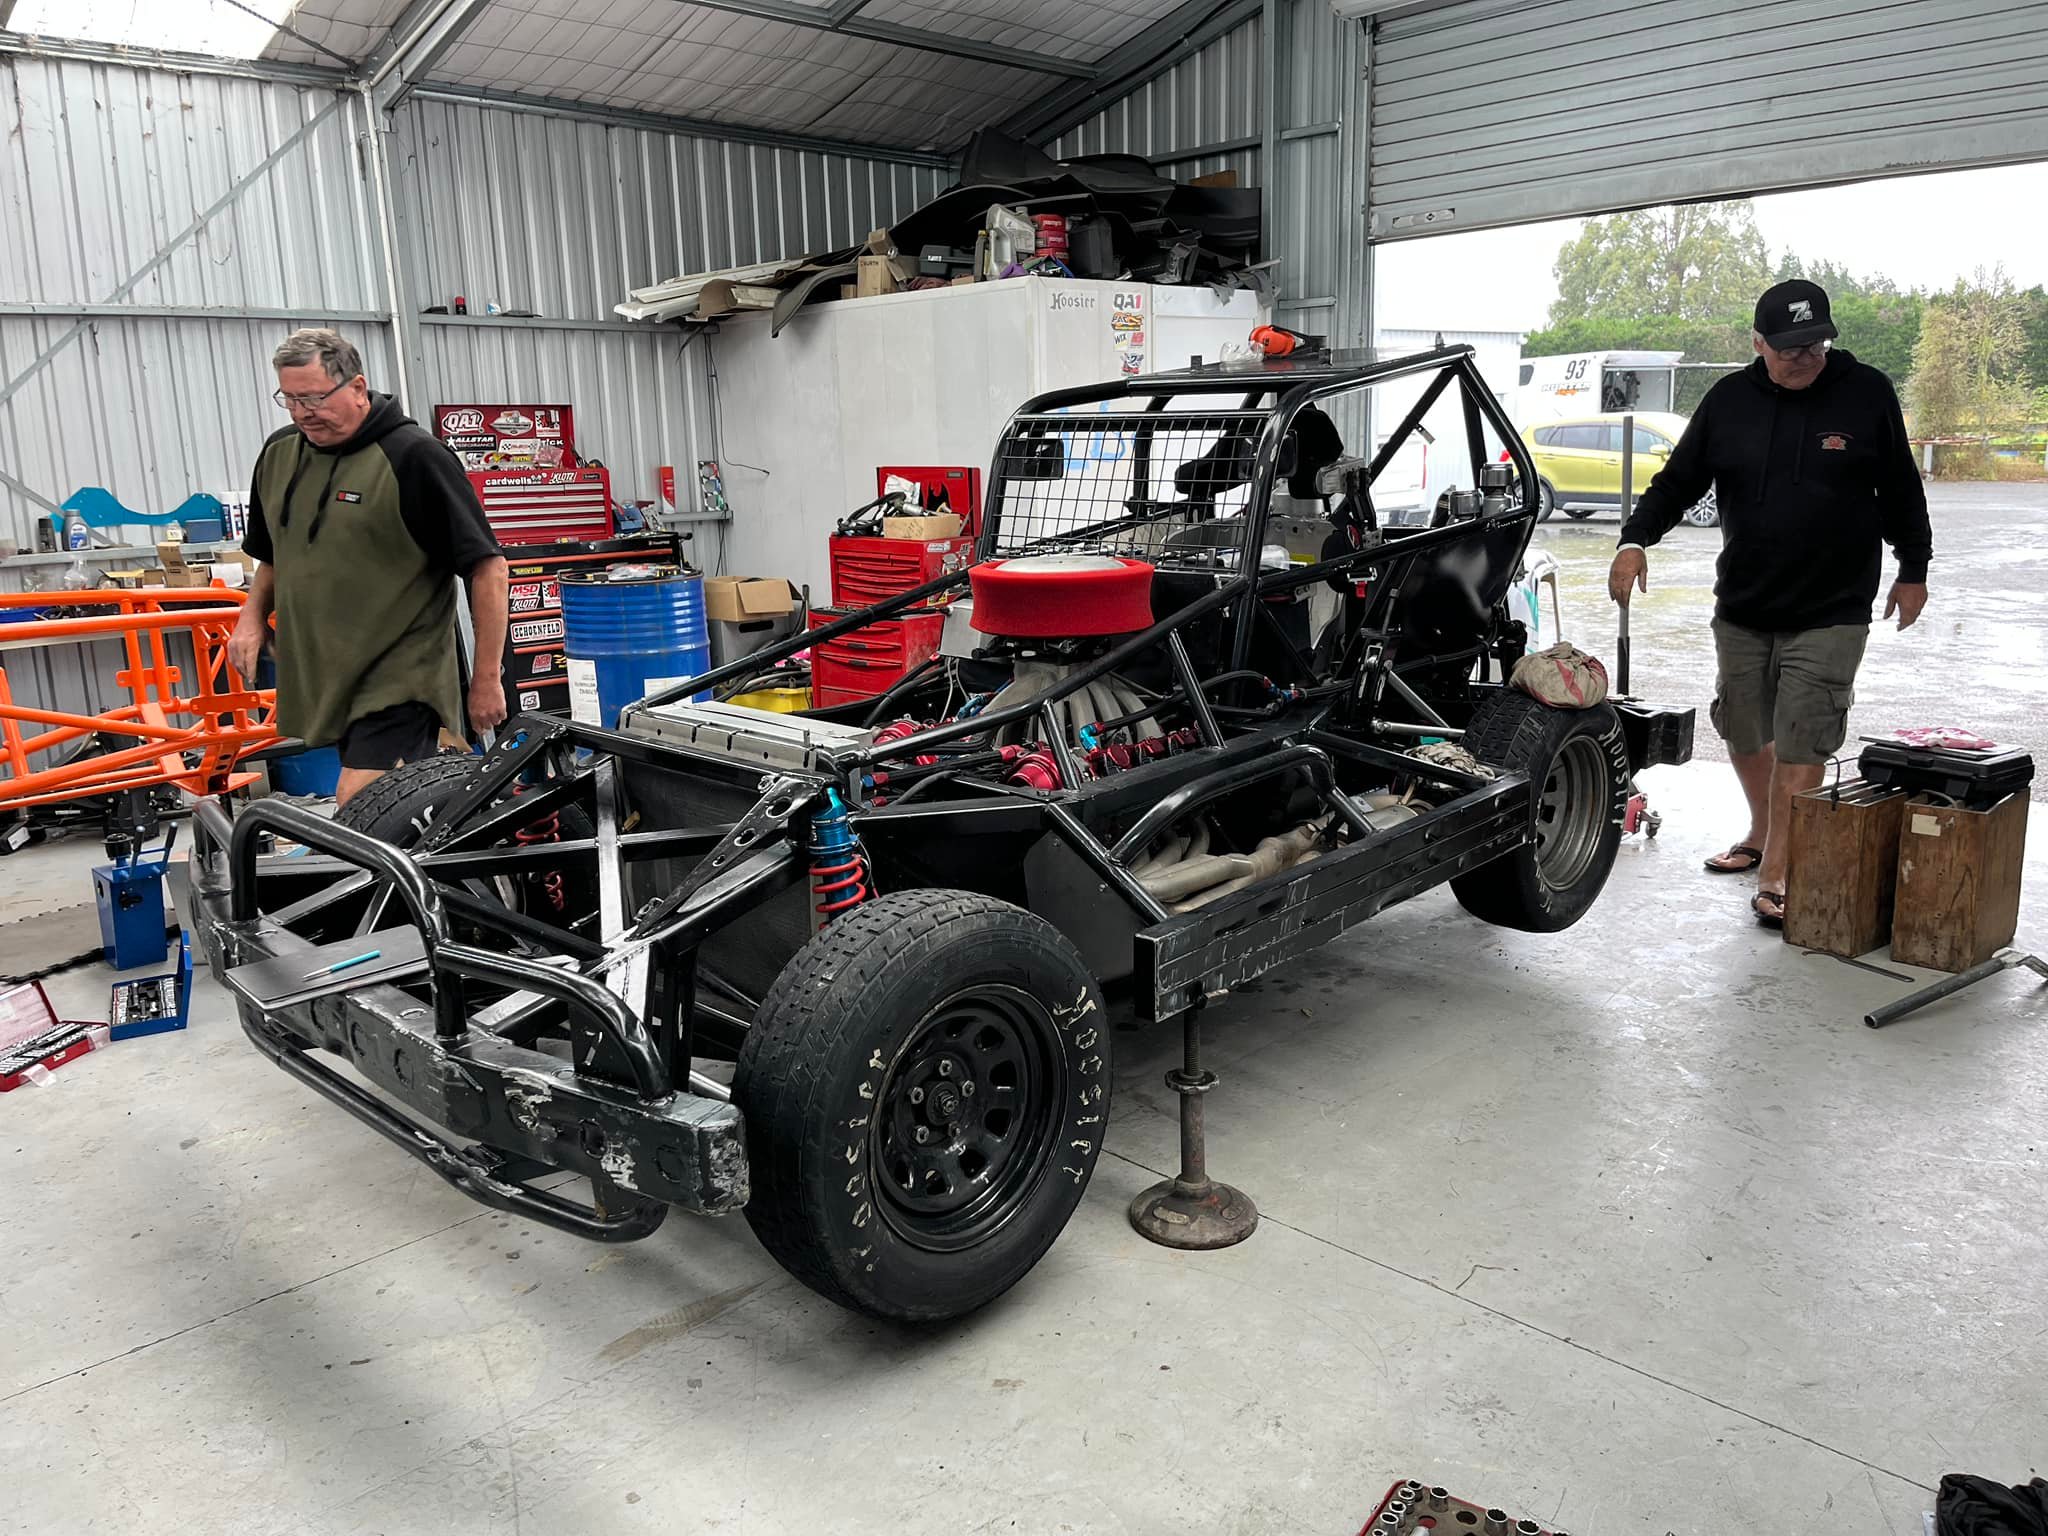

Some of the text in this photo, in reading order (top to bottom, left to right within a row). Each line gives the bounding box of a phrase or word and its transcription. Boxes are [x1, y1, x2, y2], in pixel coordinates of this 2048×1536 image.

[1050, 291, 1096, 310] Hoosier
[1113, 293, 1142, 310] QA1
[446, 414, 481, 429] QA1
[485, 477, 532, 485] cardwells
[553, 472, 575, 482] KLOTZ
[512, 585, 539, 595] MSD
[514, 599, 537, 609] KLOTZ
[514, 622, 560, 638] SCHOENFELD
